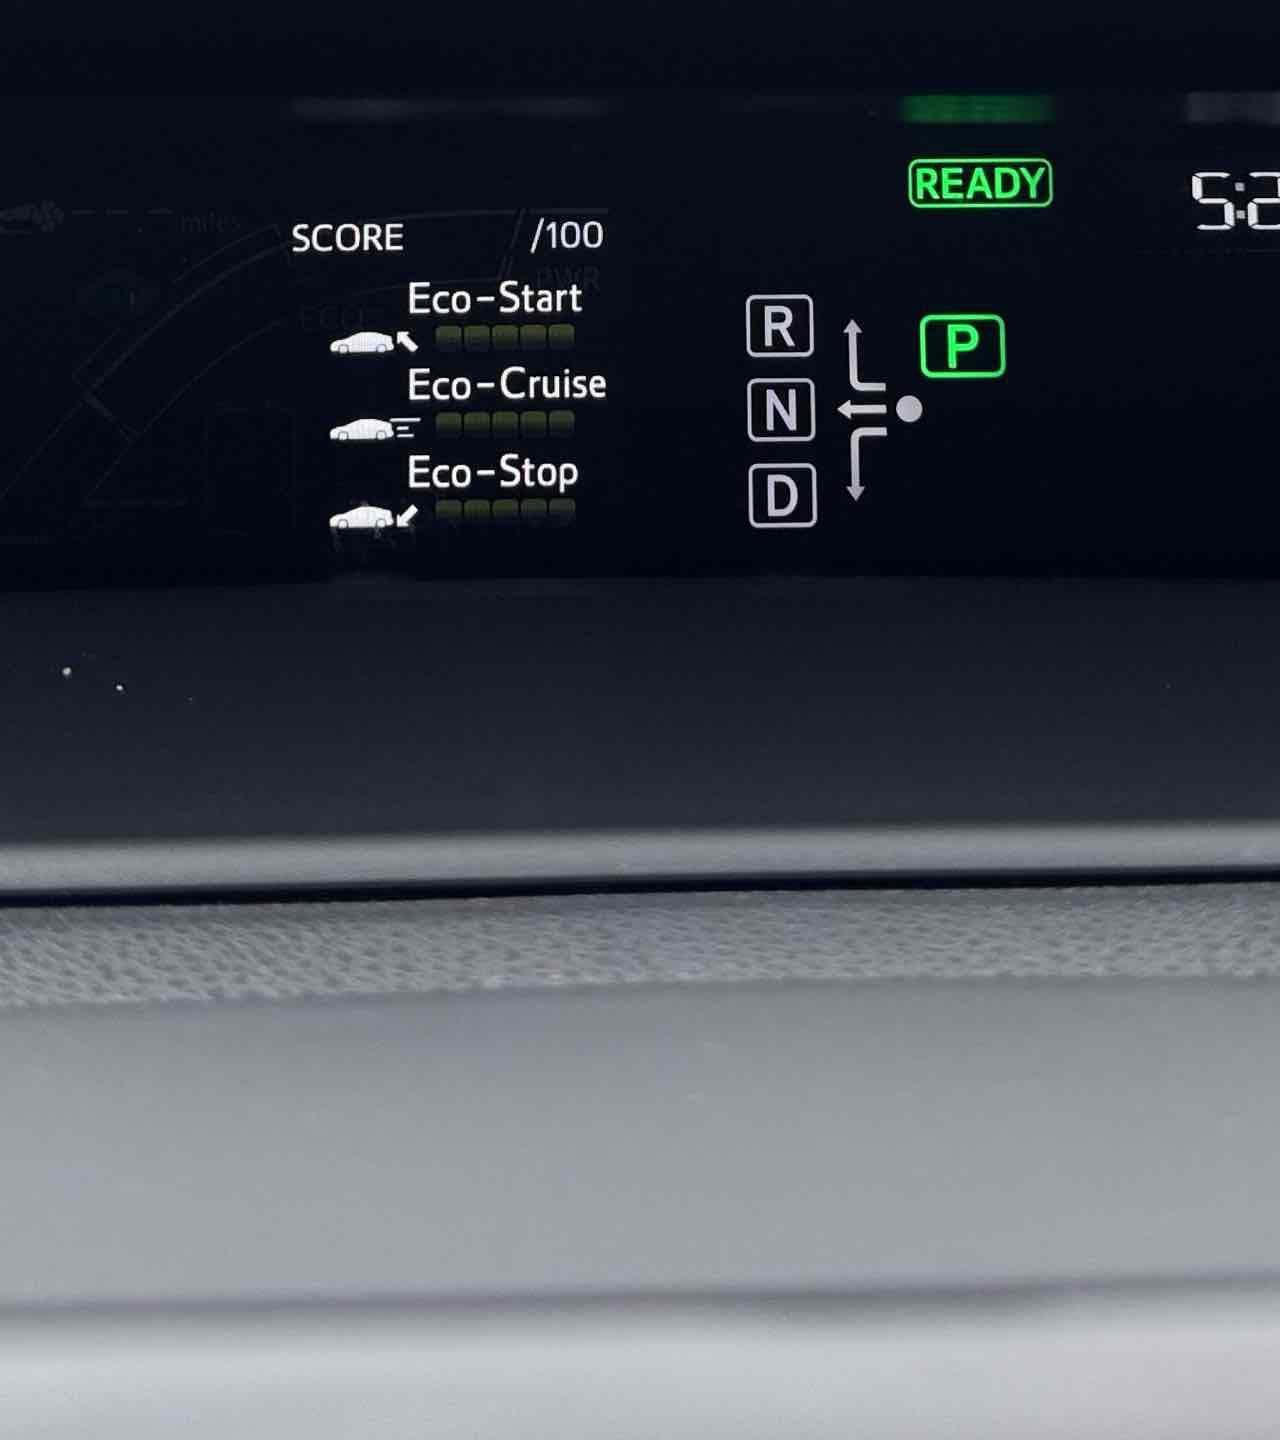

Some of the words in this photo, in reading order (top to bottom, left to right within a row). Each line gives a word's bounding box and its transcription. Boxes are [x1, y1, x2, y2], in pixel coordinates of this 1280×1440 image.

[916, 167, 1045, 200] READY
[292, 223, 404, 253] SCORE
[530, 217, 604, 254] /100
[408, 279, 583, 314] Eco-Start
[764, 305, 796, 347] R
[947, 324, 980, 369] P
[408, 365, 607, 401] Eco-Cruise
[766, 388, 797, 431] N
[408, 453, 579, 494] Eco-Stop
[767, 474, 799, 517] D
